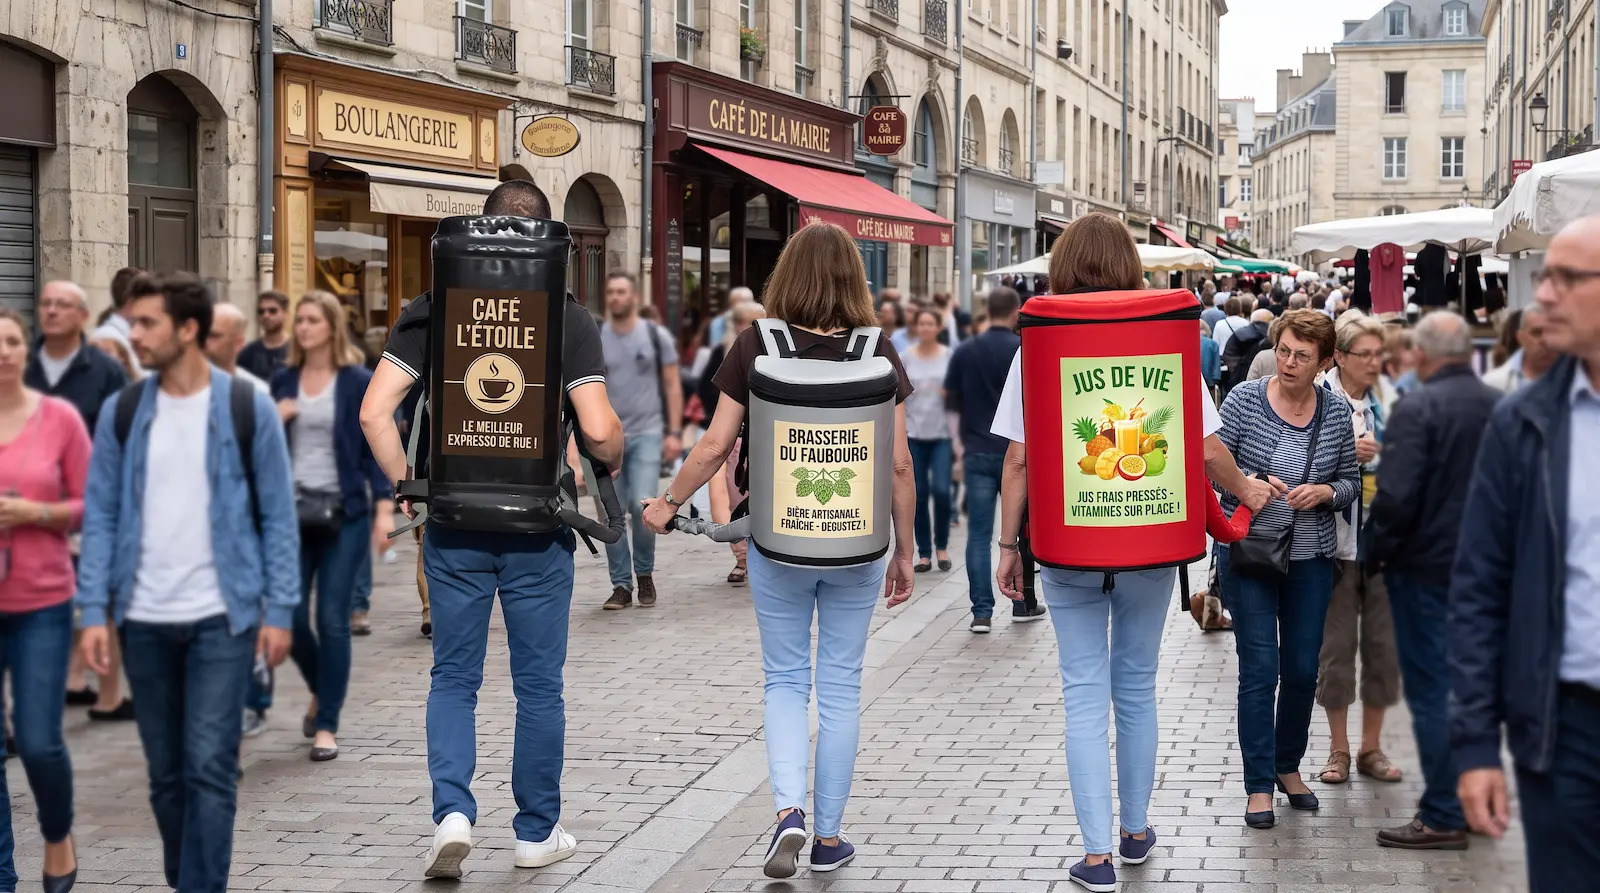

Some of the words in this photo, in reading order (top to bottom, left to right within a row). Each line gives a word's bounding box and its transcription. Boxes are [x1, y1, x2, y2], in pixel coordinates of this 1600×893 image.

[873, 111, 898, 121] CAFE
[334, 102, 459, 149] BOULANGERIE
[709, 98, 746, 135] CAFÉ
[749, 108, 768, 140] DE
[771, 114, 788, 145] LA
[790, 119, 831, 154] MAIRIE
[868, 135, 902, 145] MAIRIE
[856, 217, 874, 237] CAFÉ
[874, 221, 884, 238] DE
[884, 222, 894, 239] LA
[893, 223, 915, 241] MAIRIE
[472, 297, 521, 322] CAFÉ
[1072, 368, 1106, 396] JUS
[1110, 365, 1136, 388] DE
[1142, 366, 1174, 392] VIE
[462, 420, 475, 433] LE
[476, 420, 523, 435] MEILLEUR
[447, 433, 497, 447] EXPRESSO
[498, 435, 512, 448] DE
[513, 436, 532, 449] RUE
[534, 437, 538, 450] !
[788, 428, 860, 446] BRASSERIE
[780, 445, 797, 462] DU
[801, 445, 868, 463] FAUBOURG
[1077, 491, 1094, 503] JUS
[1096, 491, 1124, 503] FRAIS
[1126, 486, 1168, 503] PRESSÉS
[787, 506, 810, 519] BIÈRE
[811, 508, 860, 520] ARTISANALE
[1071, 505, 1122, 518] VITAMINES
[1124, 504, 1143, 517] SUR
[1145, 502, 1175, 516] PLACE
[821, 520, 861, 532] DEGUSTEZ
